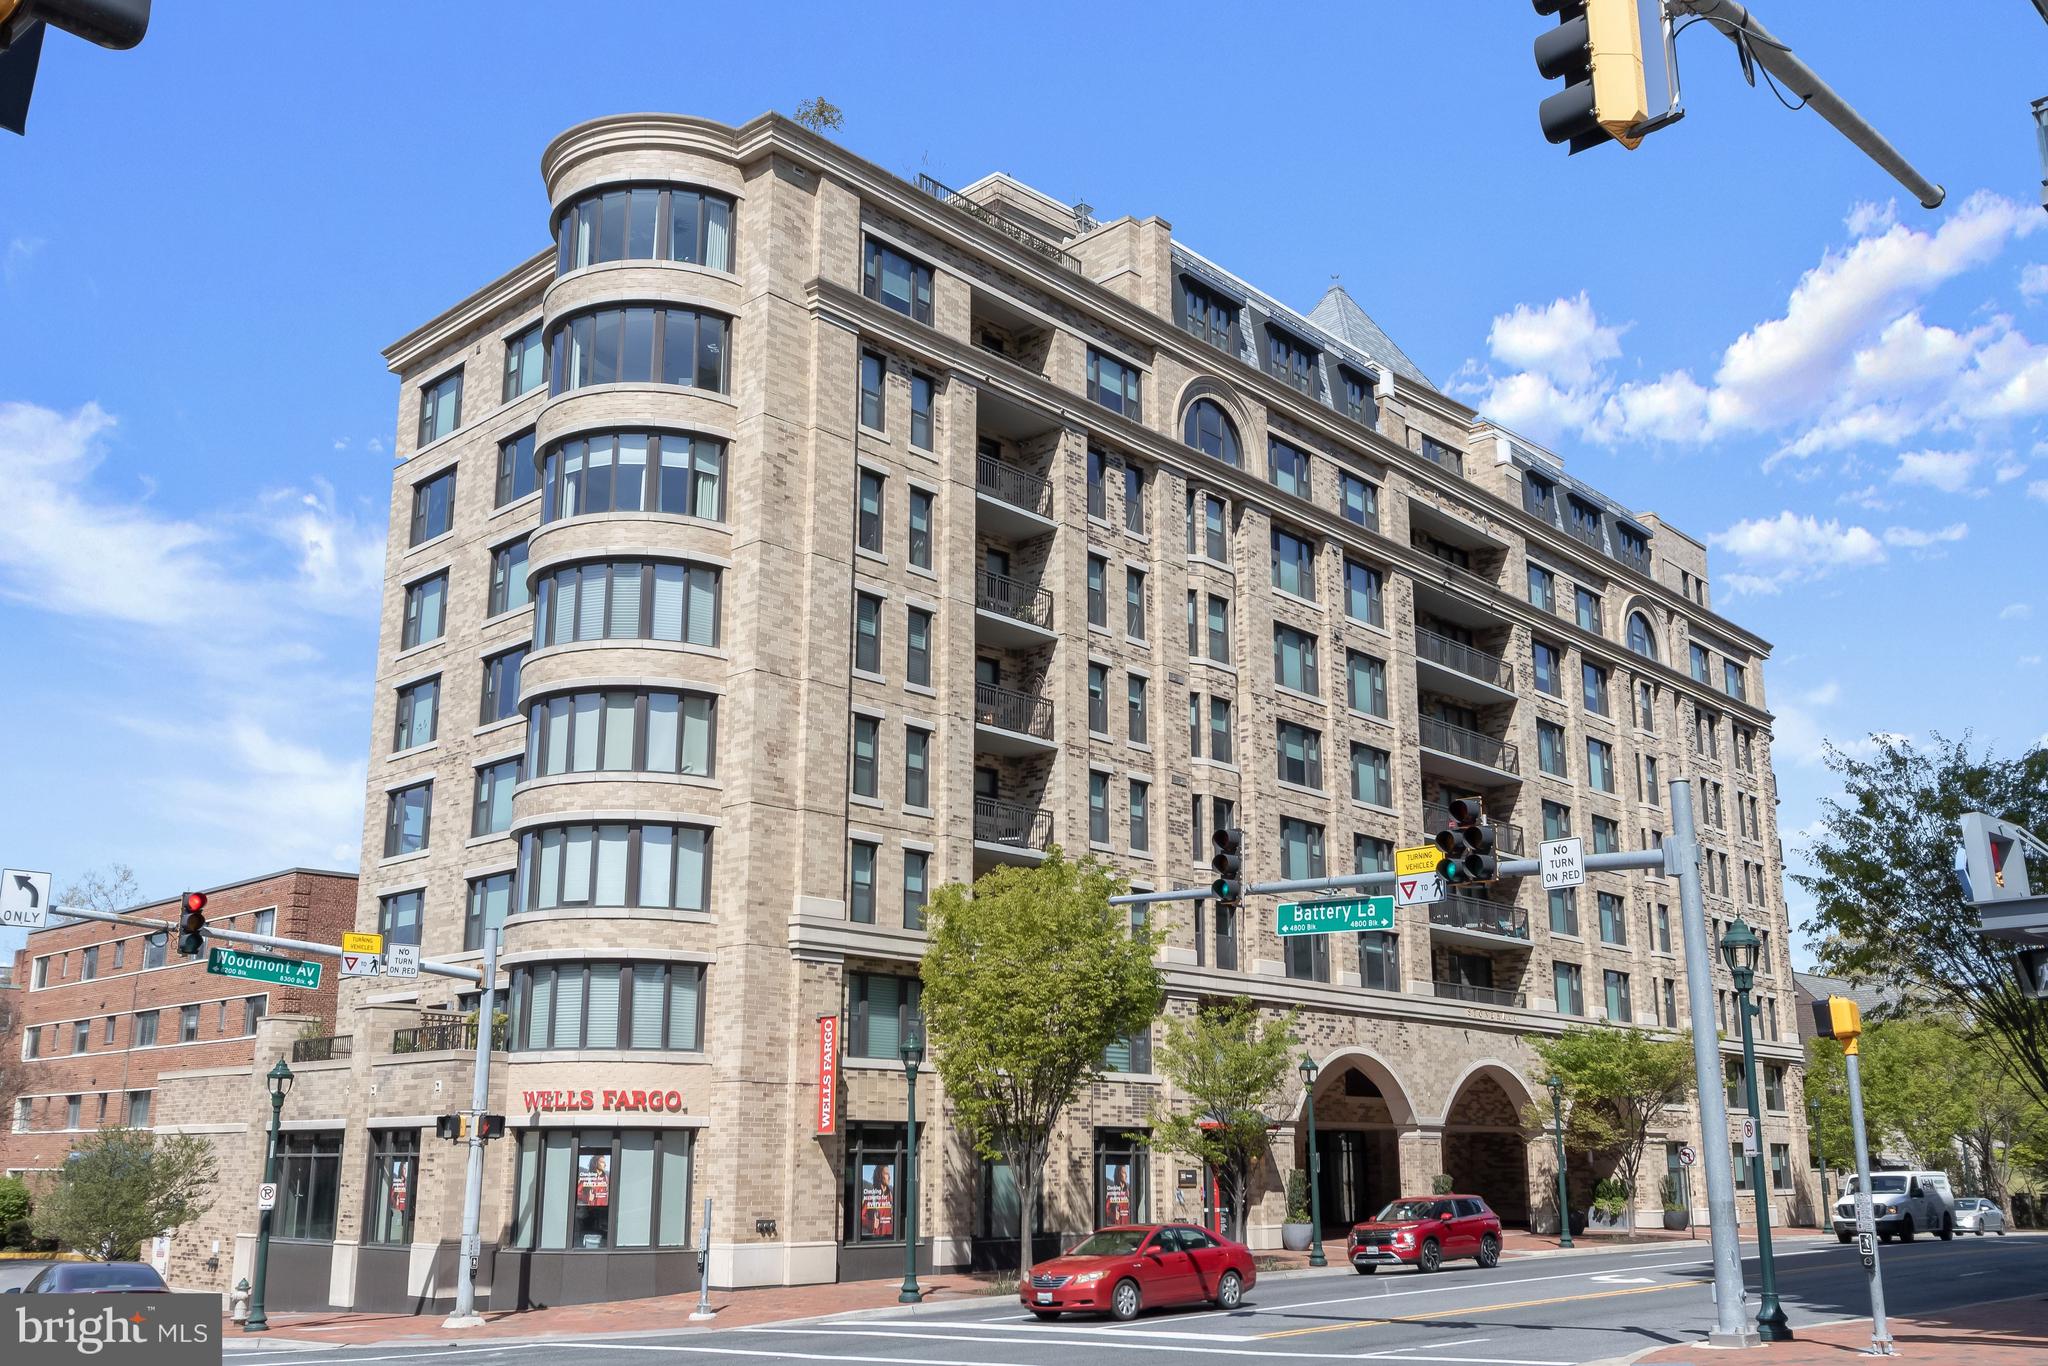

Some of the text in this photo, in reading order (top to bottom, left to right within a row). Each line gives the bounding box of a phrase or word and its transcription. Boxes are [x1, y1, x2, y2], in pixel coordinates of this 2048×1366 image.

[1553, 845, 1568, 855] NO
[1406, 851, 1433, 861] TURNING
[1405, 861, 1434, 871] VEHICLES
[1550, 857, 1574, 868] TURN
[1546, 870, 1580, 882] ON RED
[1294, 900, 1376, 922] Battery La
[4, 910, 40, 923] ONLY
[1289, 924, 1305, 932] 4800
[1350, 920, 1366, 928] 4800
[398, 947, 410, 955] NO
[217, 950, 291, 974] Woodmont
[395, 957, 413, 965] TURN
[389, 966, 416, 975] ON RED
[279, 975, 295, 983] 8300
[822, 1019, 833, 1128] WELLS FARGO
[523, 1090, 682, 1112] WELLS FARGO
